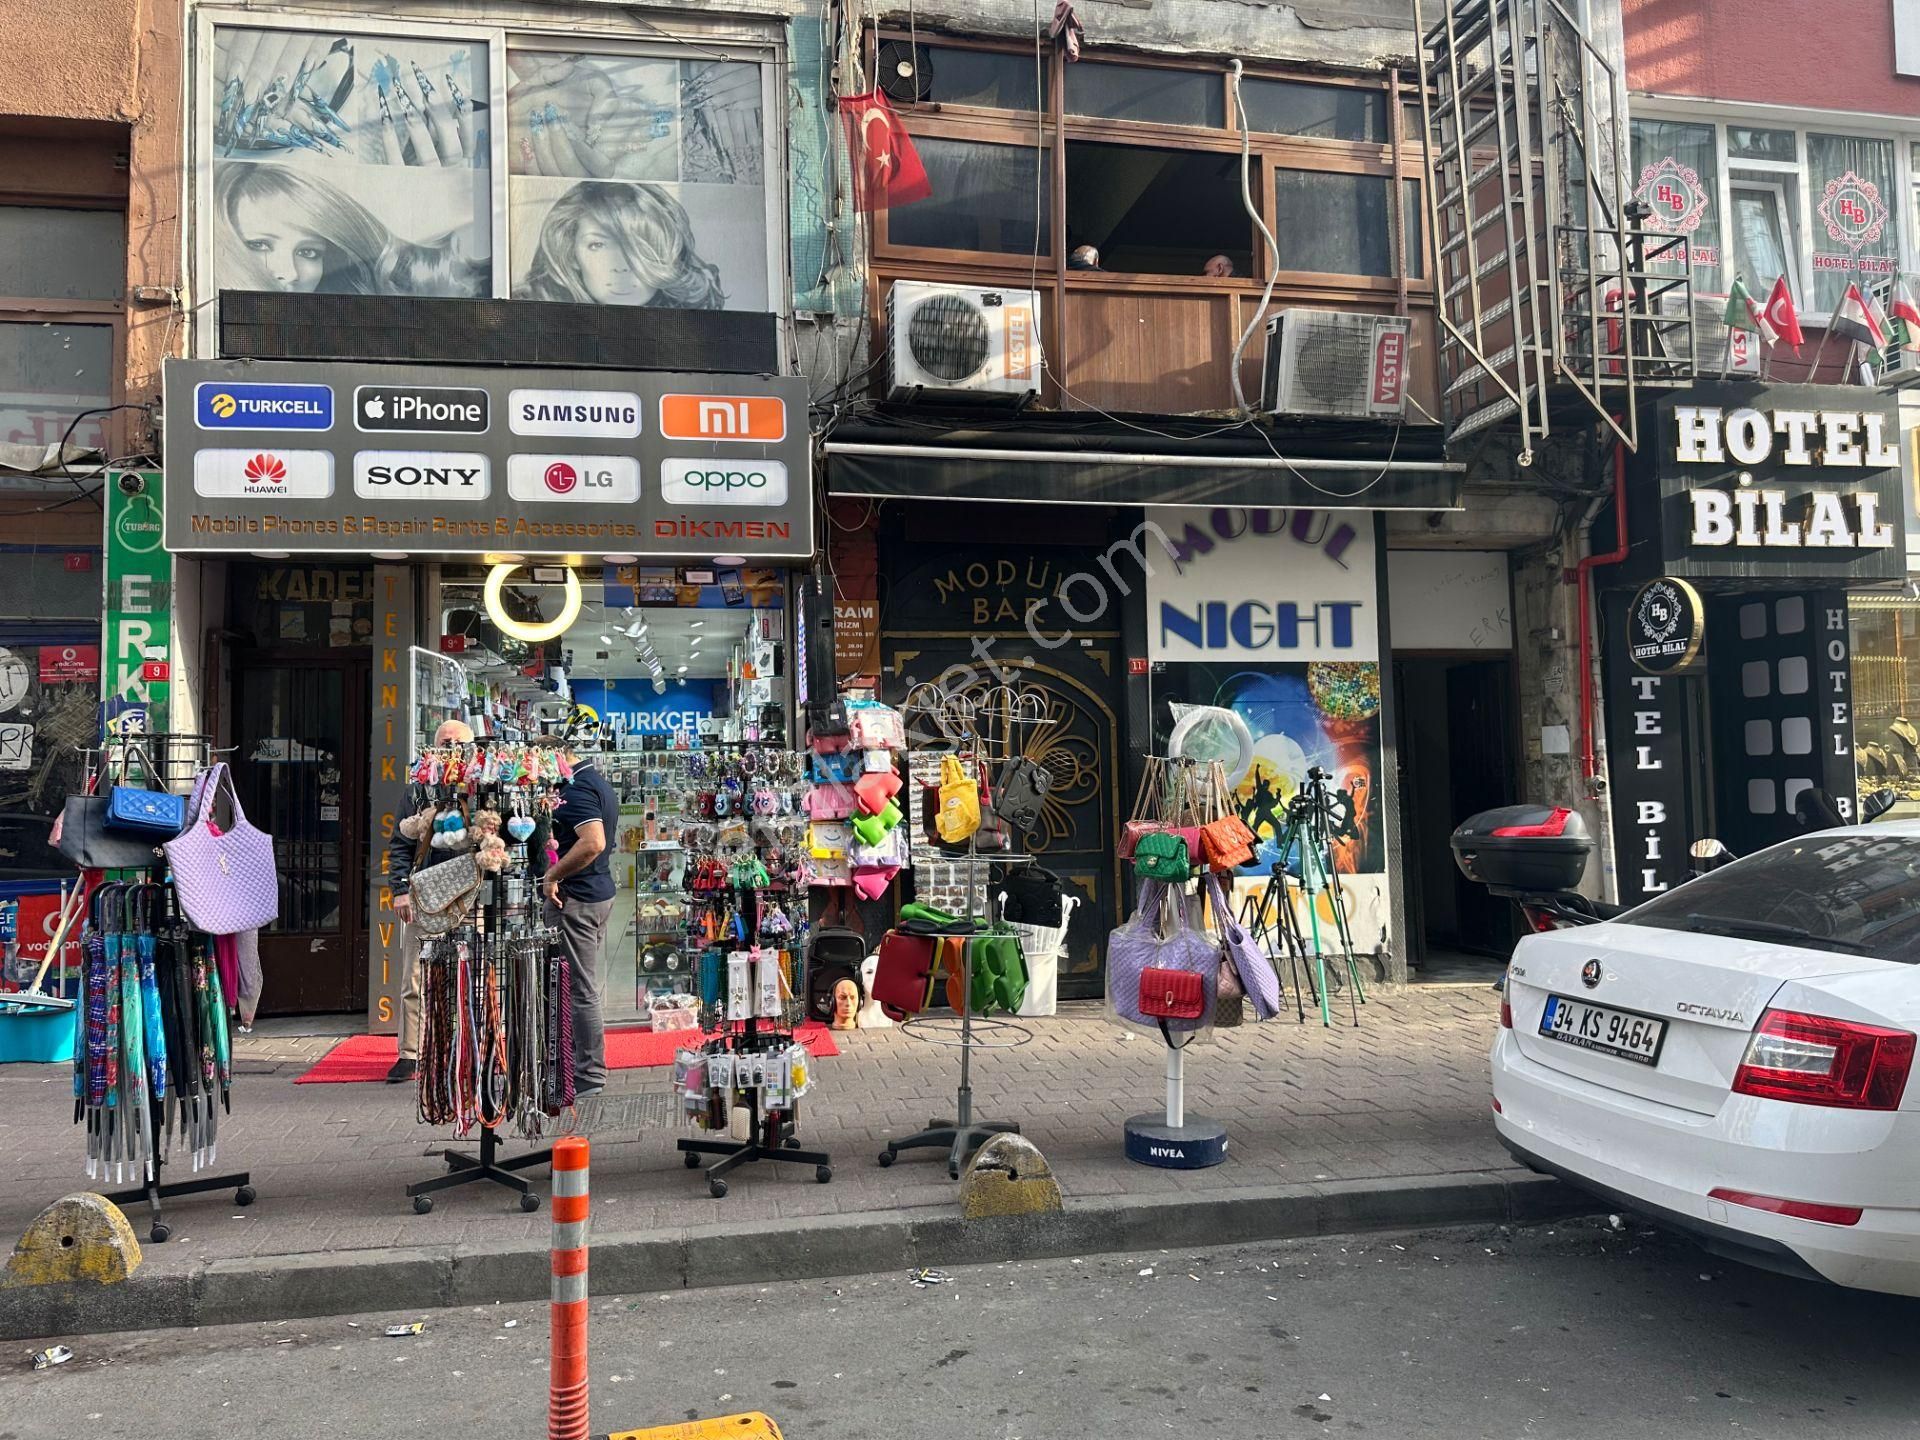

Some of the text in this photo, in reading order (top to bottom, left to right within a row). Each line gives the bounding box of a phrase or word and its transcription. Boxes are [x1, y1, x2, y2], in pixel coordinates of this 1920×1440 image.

[1657, 185, 1684, 211] HB
[1839, 199, 1866, 224] HB
[1676, 249, 1717, 262] BLAL
[1815, 257, 1855, 270] HOTEL
[1009, 312, 1025, 374] VESTEL
[1733, 333, 1747, 366] VES
[1381, 335, 1399, 400] VESTEL
[239, 399, 323, 415] TURKCELL
[392, 396, 481, 421] iPhone
[522, 403, 636, 425] SAMSUNG
[1674, 405, 1901, 468] HOTEL
[367, 466, 481, 486] SONY
[584, 470, 613, 488] LG
[684, 470, 767, 492] oppo
[244, 486, 287, 494] HUAWEI
[1688, 470, 1895, 547] BİLAL
[191, 515, 259, 533] Mobile
[263, 515, 338, 534] Phones
[342, 515, 358, 533] &
[362, 516, 428, 538] Repair
[432, 516, 490, 535] Parts
[495, 517, 510, 535] &
[655, 515, 790, 538] DİKMEN
[933, 556, 1072, 605] MODÜL
[973, 597, 1046, 625] BAR
[1651, 603, 1668, 621] HB
[1160, 600, 1362, 649] NIGHT
[1635, 641, 1687, 657] HOTEL BİLAL
[152, 666, 161, 677] 9
[381, 576, 398, 782] TEKNİK
[1826, 608, 1849, 756] HOTEL
[27, 939, 80, 951] vodon
[1677, 1002, 1744, 1023] OCTAVIA
[1554, 1003, 1573, 1031] 34
[1579, 1008, 1604, 1038] KS
[1606, 1015, 1654, 1052] 9464
[1150, 1146, 1185, 1159] NIVEA
